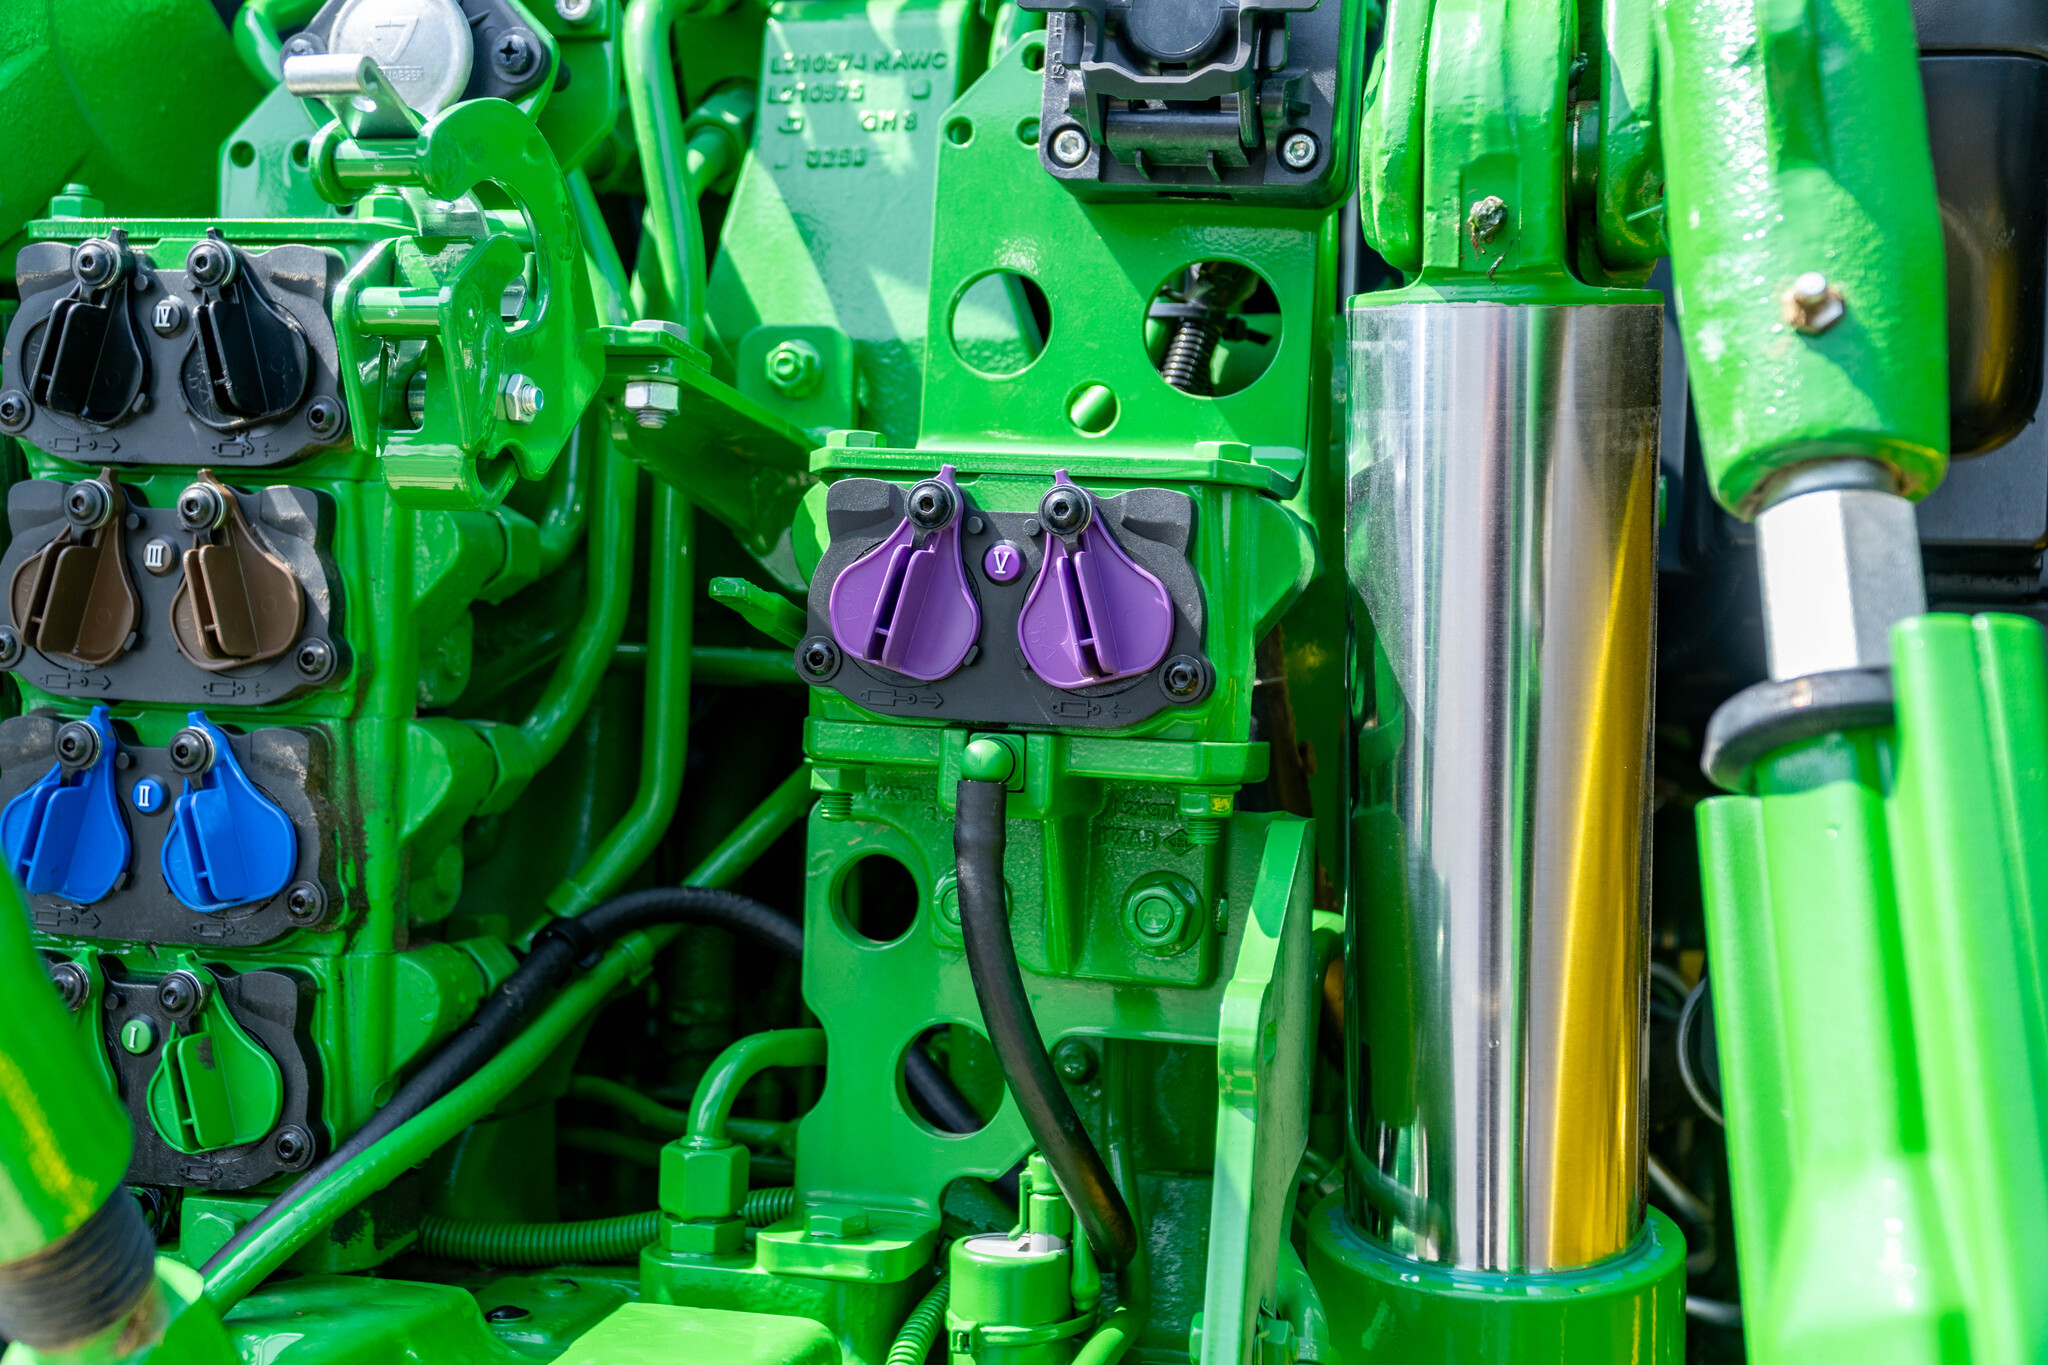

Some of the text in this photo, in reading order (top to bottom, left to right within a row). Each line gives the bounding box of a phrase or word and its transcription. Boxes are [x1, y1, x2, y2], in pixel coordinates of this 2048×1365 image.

[154, 305, 172, 328] IV
[145, 544, 164, 568] III
[993, 551, 1011, 574] V
[138, 785, 150, 807] II
[129, 1026, 138, 1049] I
